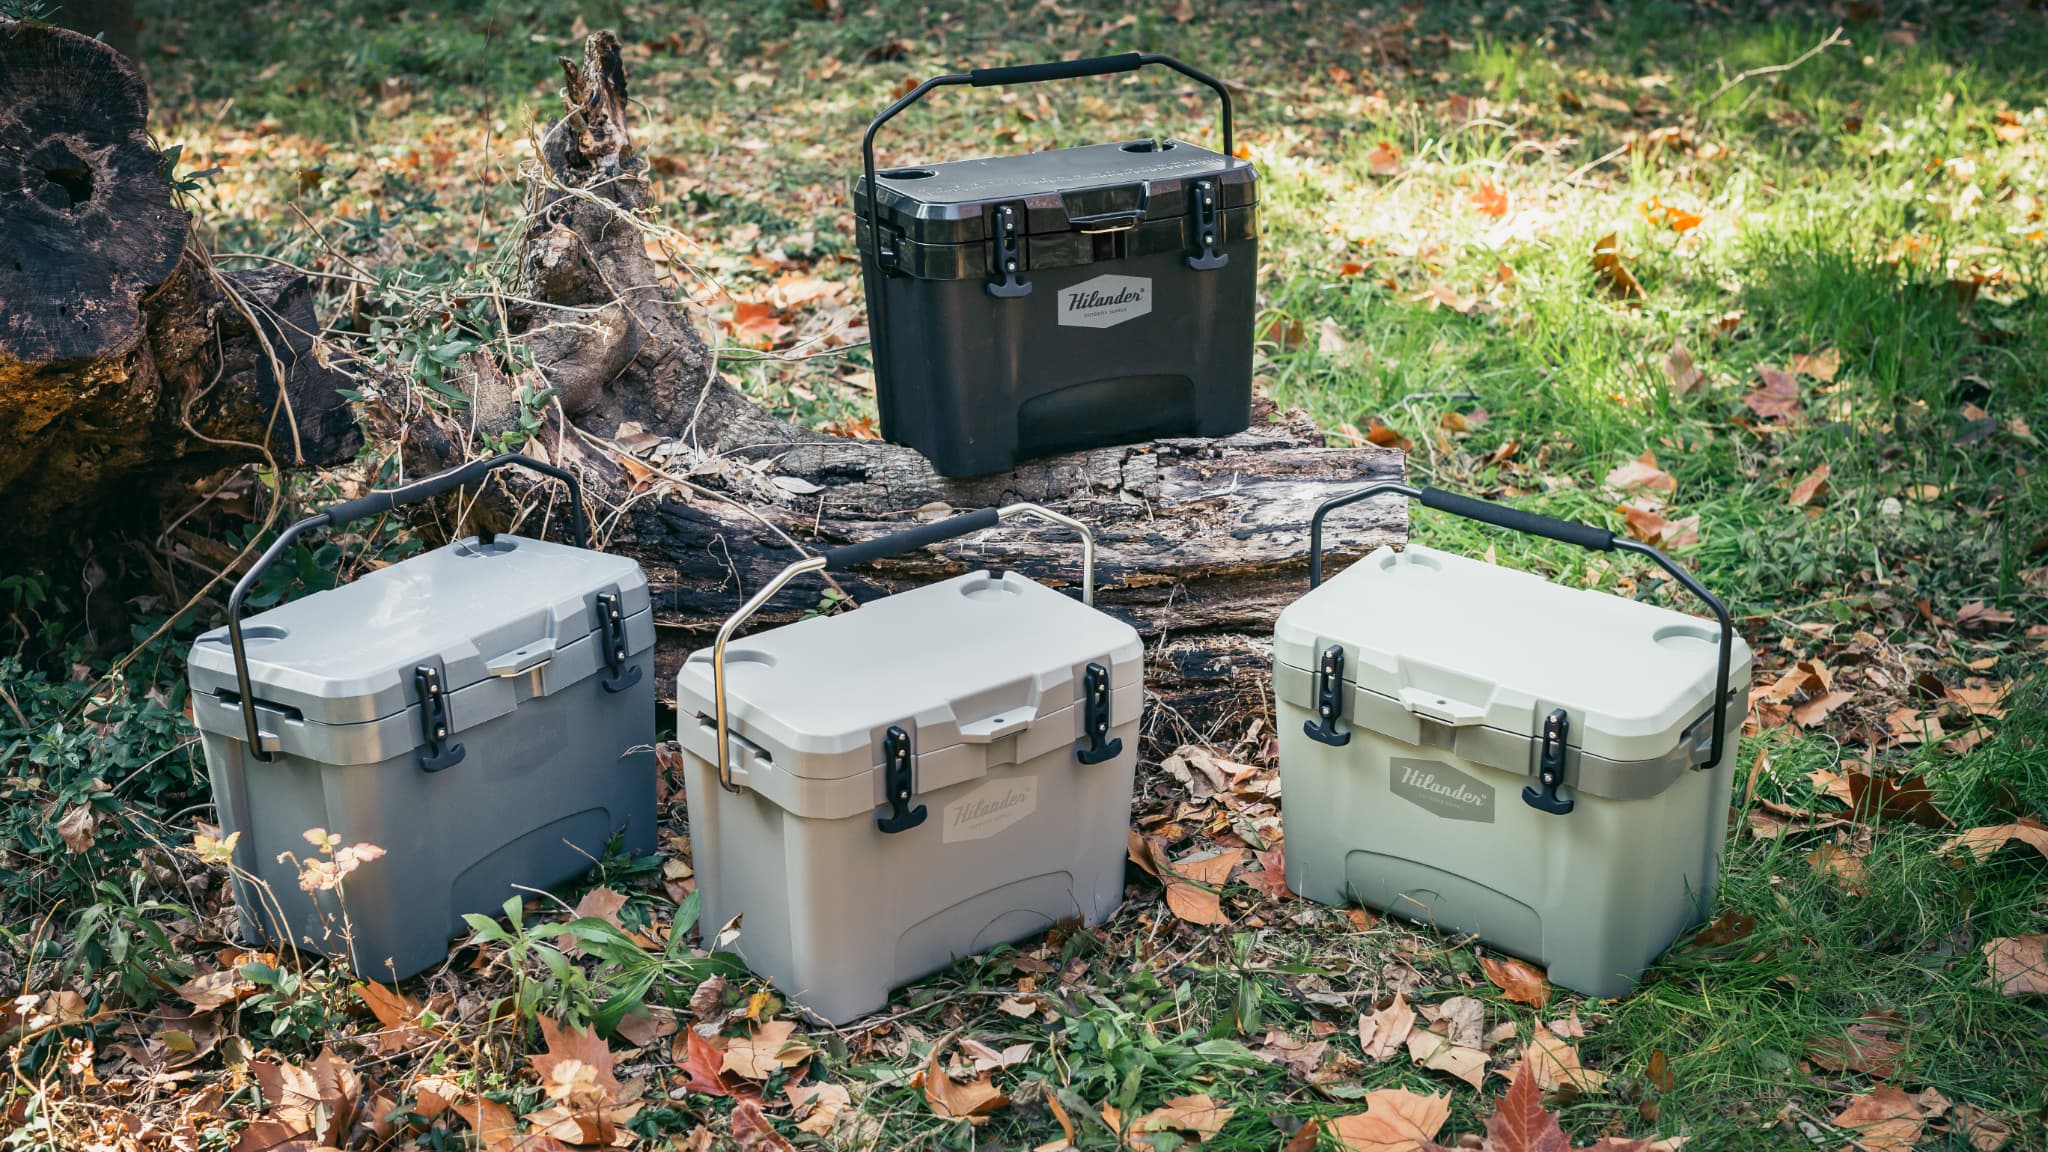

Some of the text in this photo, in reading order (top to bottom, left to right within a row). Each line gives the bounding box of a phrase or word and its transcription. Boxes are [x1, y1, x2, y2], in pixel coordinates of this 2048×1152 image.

[1068, 286, 1143, 312] Hilander
[1400, 766, 1484, 807] Hilander
[953, 788, 1027, 827] Hilander
